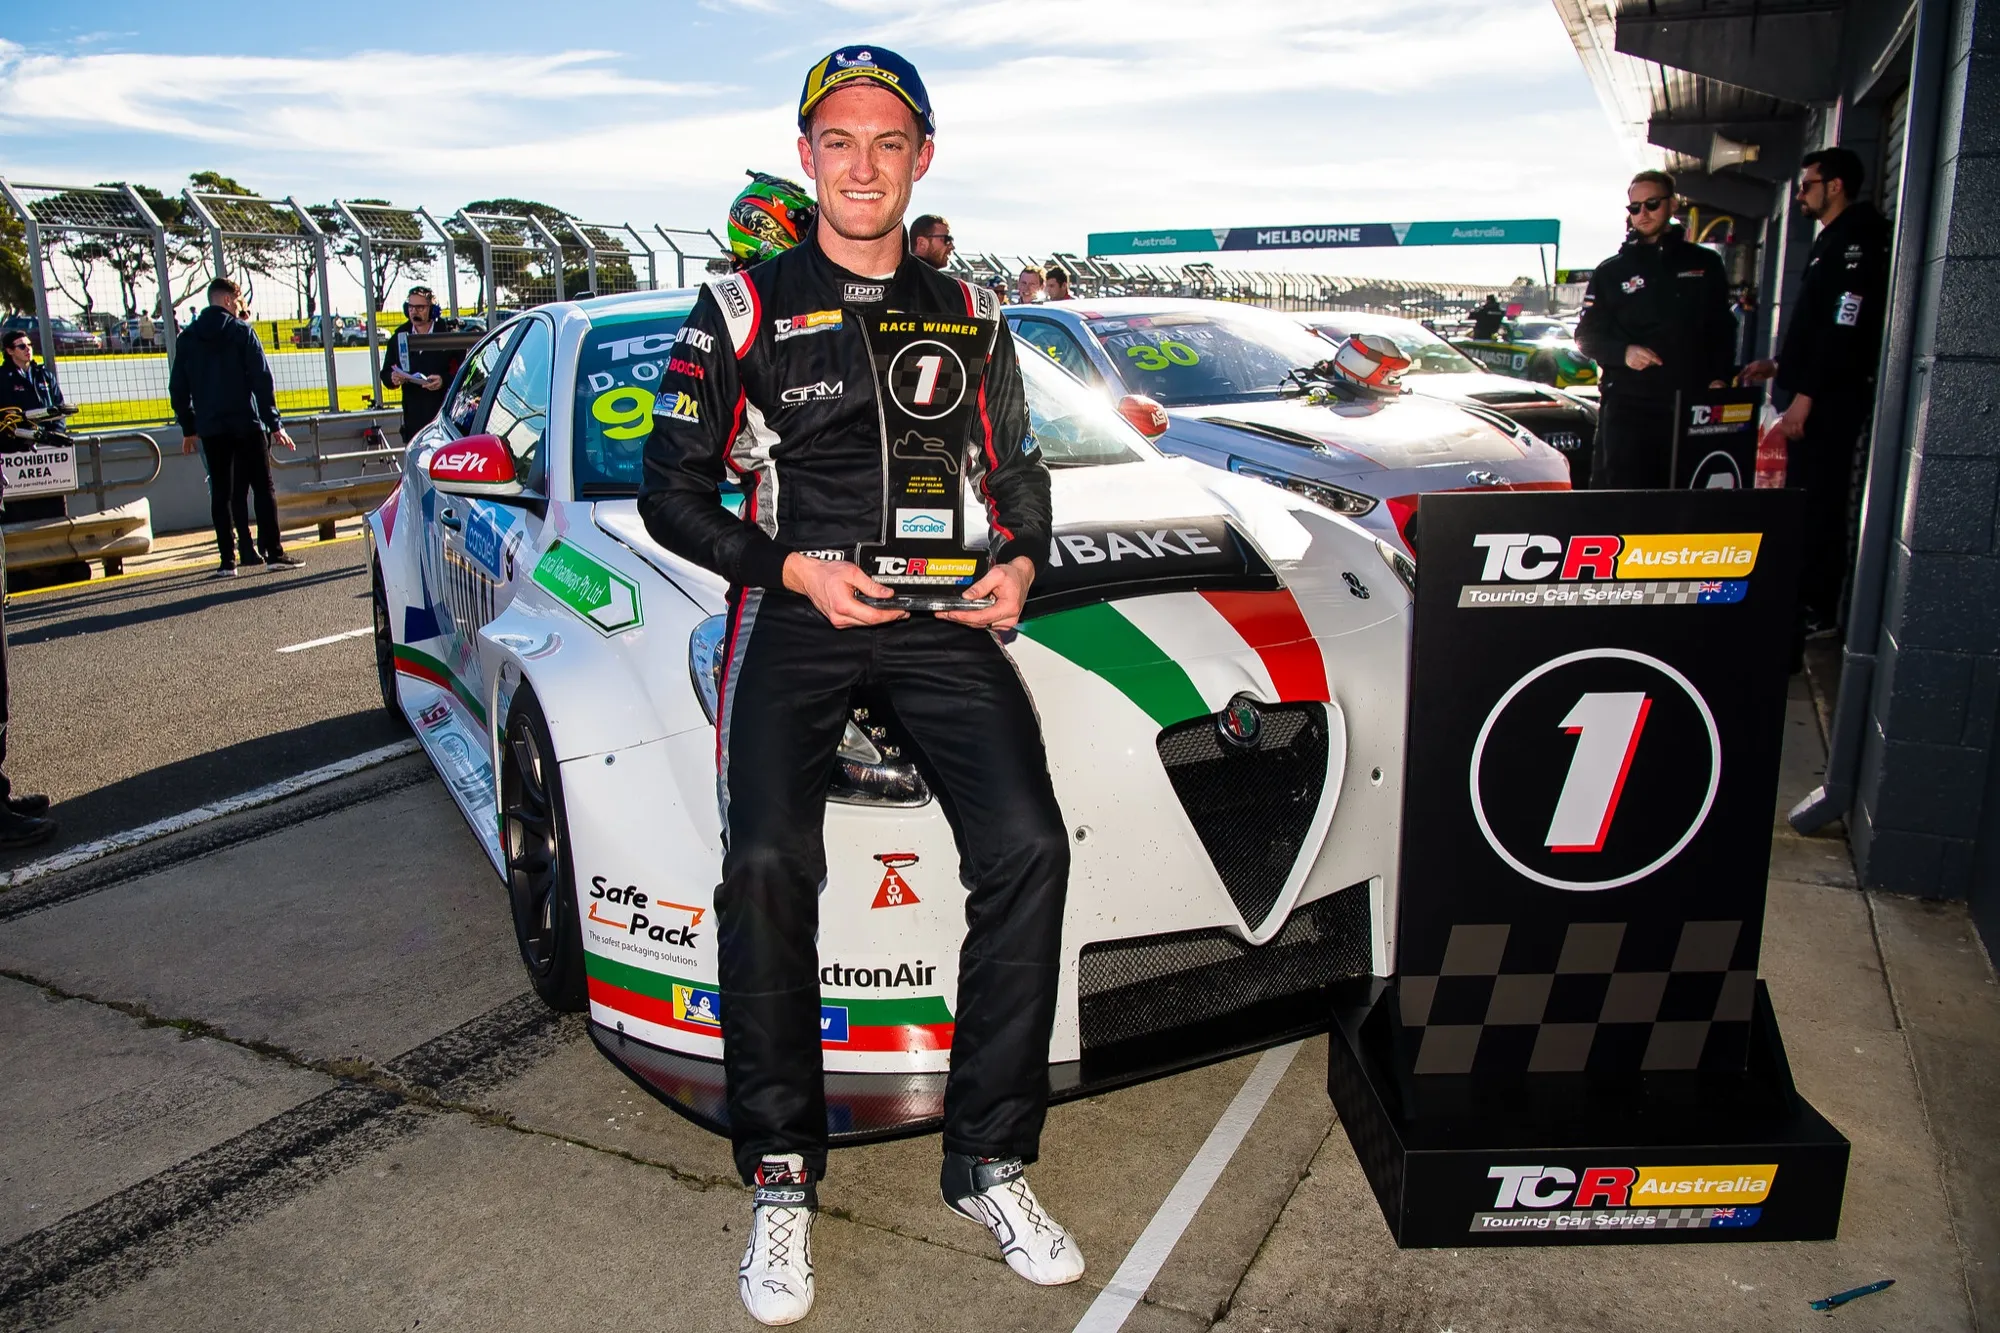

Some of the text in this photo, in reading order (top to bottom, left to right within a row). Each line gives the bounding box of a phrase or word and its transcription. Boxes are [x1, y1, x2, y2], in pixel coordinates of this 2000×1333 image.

[1132, 236, 1177, 247] Australia
[1256, 228, 1361, 245] MELBOURNE
[1451, 226, 1505, 238] Australia
[726, 282, 747, 313] rpm
[848, 286, 882, 295] rpm
[775, 315, 808, 334] TCR
[1841, 302, 1858, 322] 30
[879, 322, 978, 336] RACE WINNER
[1126, 341, 1200, 371] 30
[781, 381, 843, 402] GRM
[915, 355, 944, 406] 1
[592, 387, 655, 440] 9
[18, 467, 52, 480] AREA
[902, 523, 945, 533] carsales
[468, 527, 495, 567] carsales
[1472, 533, 1753, 581] TCR Australia
[540, 551, 561, 574] Local
[576, 574, 593, 602] Pty
[586, 581, 607, 605] Ltd
[875, 556, 974, 575] TCR Australia
[1468, 587, 1644, 604] Touring Car Series
[1544, 692, 1653, 853] 1
[589, 875, 649, 909] Safe
[886, 874, 903, 905] TOW
[629, 913, 700, 949] Pack
[589, 930, 698, 967] The safest packaging solutions
[819, 960, 937, 988] ctronAir
[1487, 1165, 1768, 1208] TCR Australia
[1480, 1214, 1657, 1229] Touring Car Series
